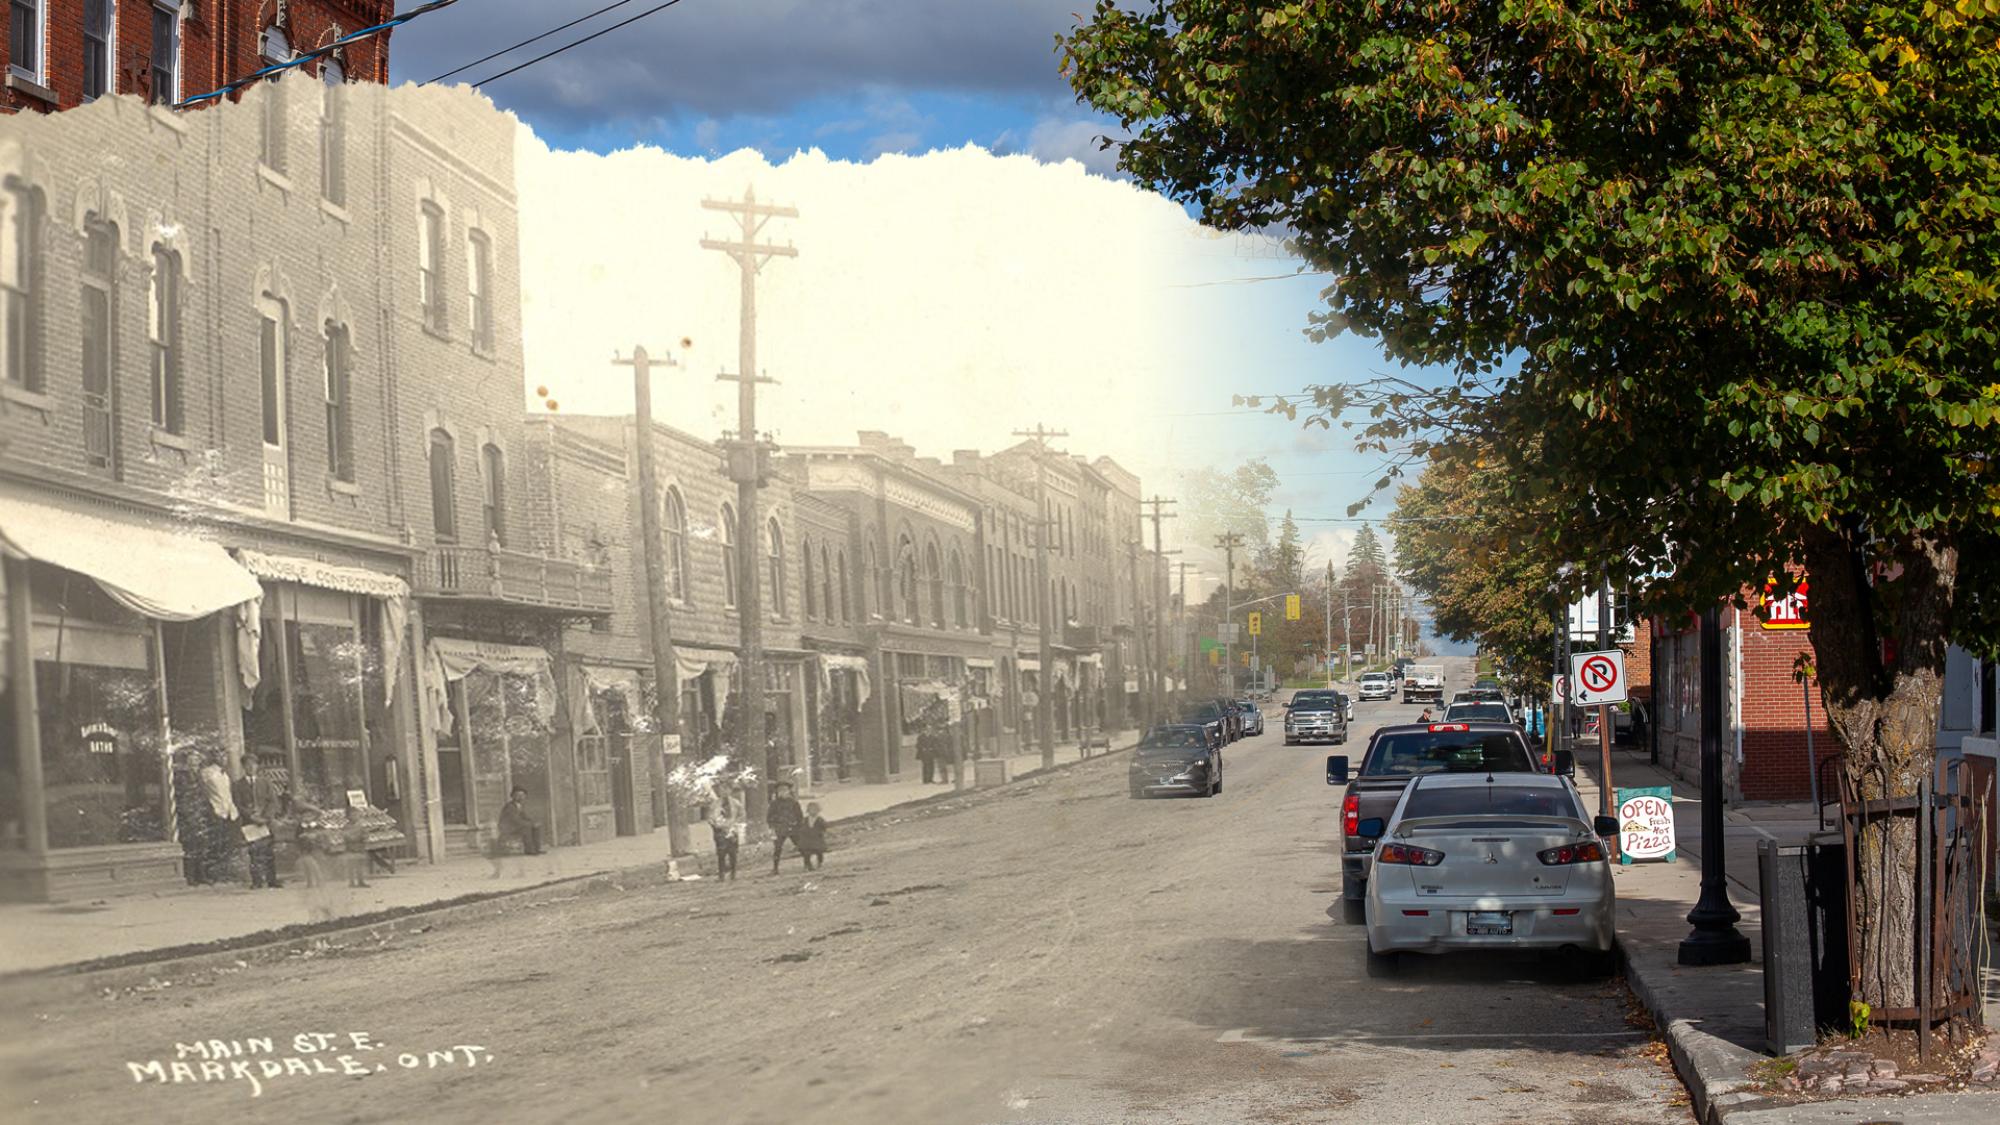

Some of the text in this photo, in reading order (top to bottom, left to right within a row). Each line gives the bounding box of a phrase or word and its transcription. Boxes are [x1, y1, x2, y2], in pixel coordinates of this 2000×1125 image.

[315, 569, 401, 592] CONFECTIONERY
[1622, 799, 1668, 819] OPEN
[1625, 833, 1671, 851] Pizza
